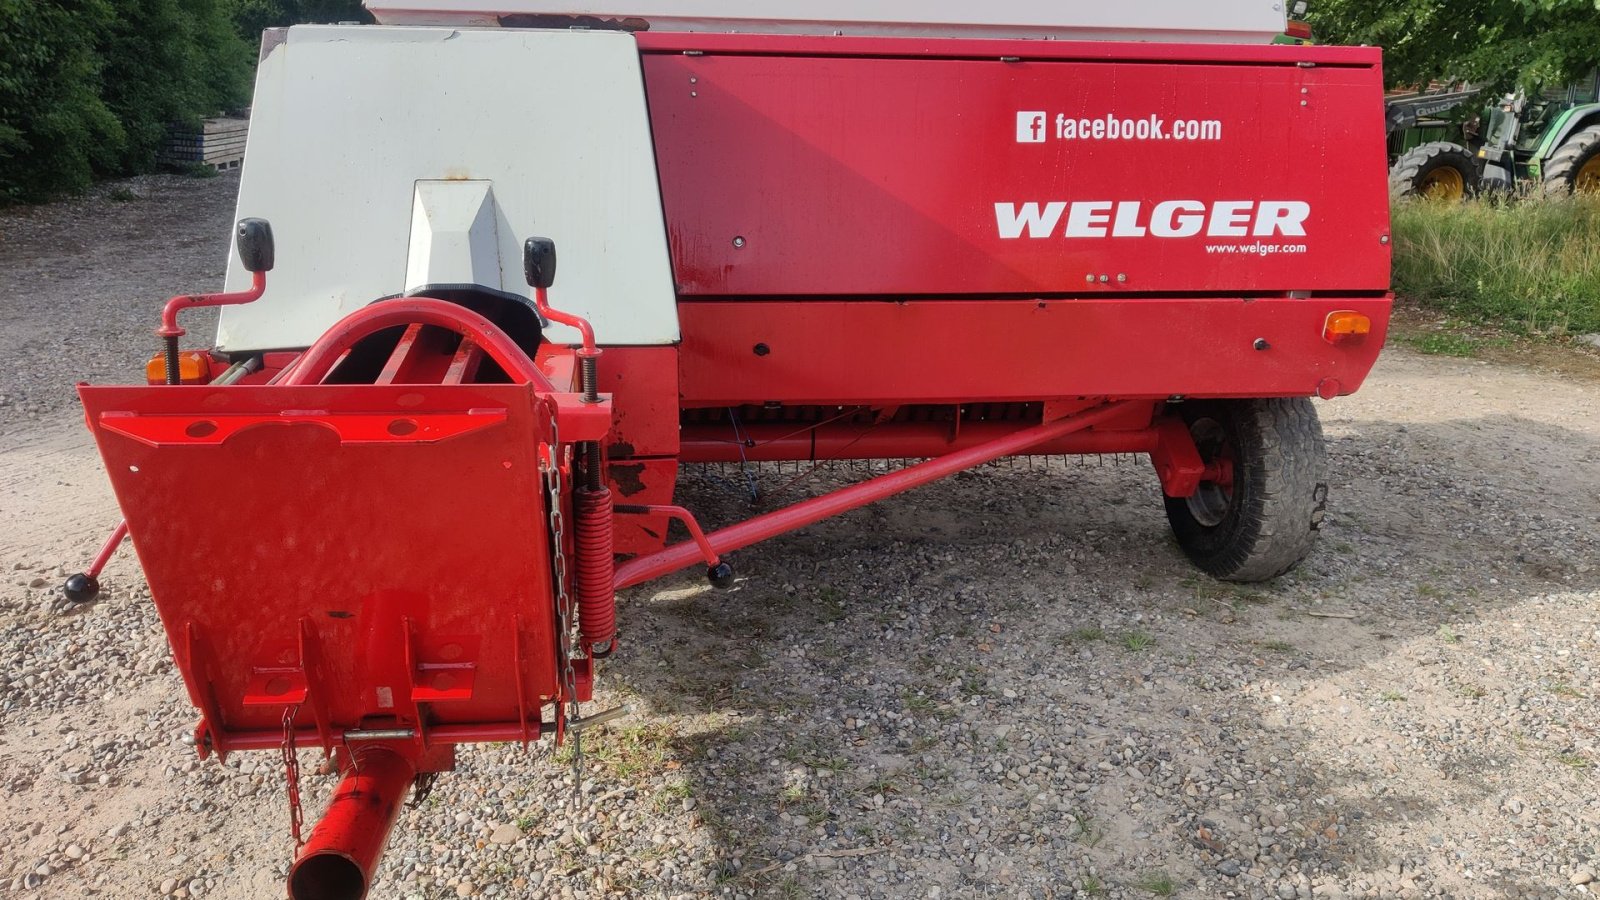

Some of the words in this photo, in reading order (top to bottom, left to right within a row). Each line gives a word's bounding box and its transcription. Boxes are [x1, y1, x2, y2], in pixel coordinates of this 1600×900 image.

[1055, 113, 1222, 140] facebook.com
[994, 200, 1311, 239] WELGER
[1206, 242, 1307, 257] www.welger.com
